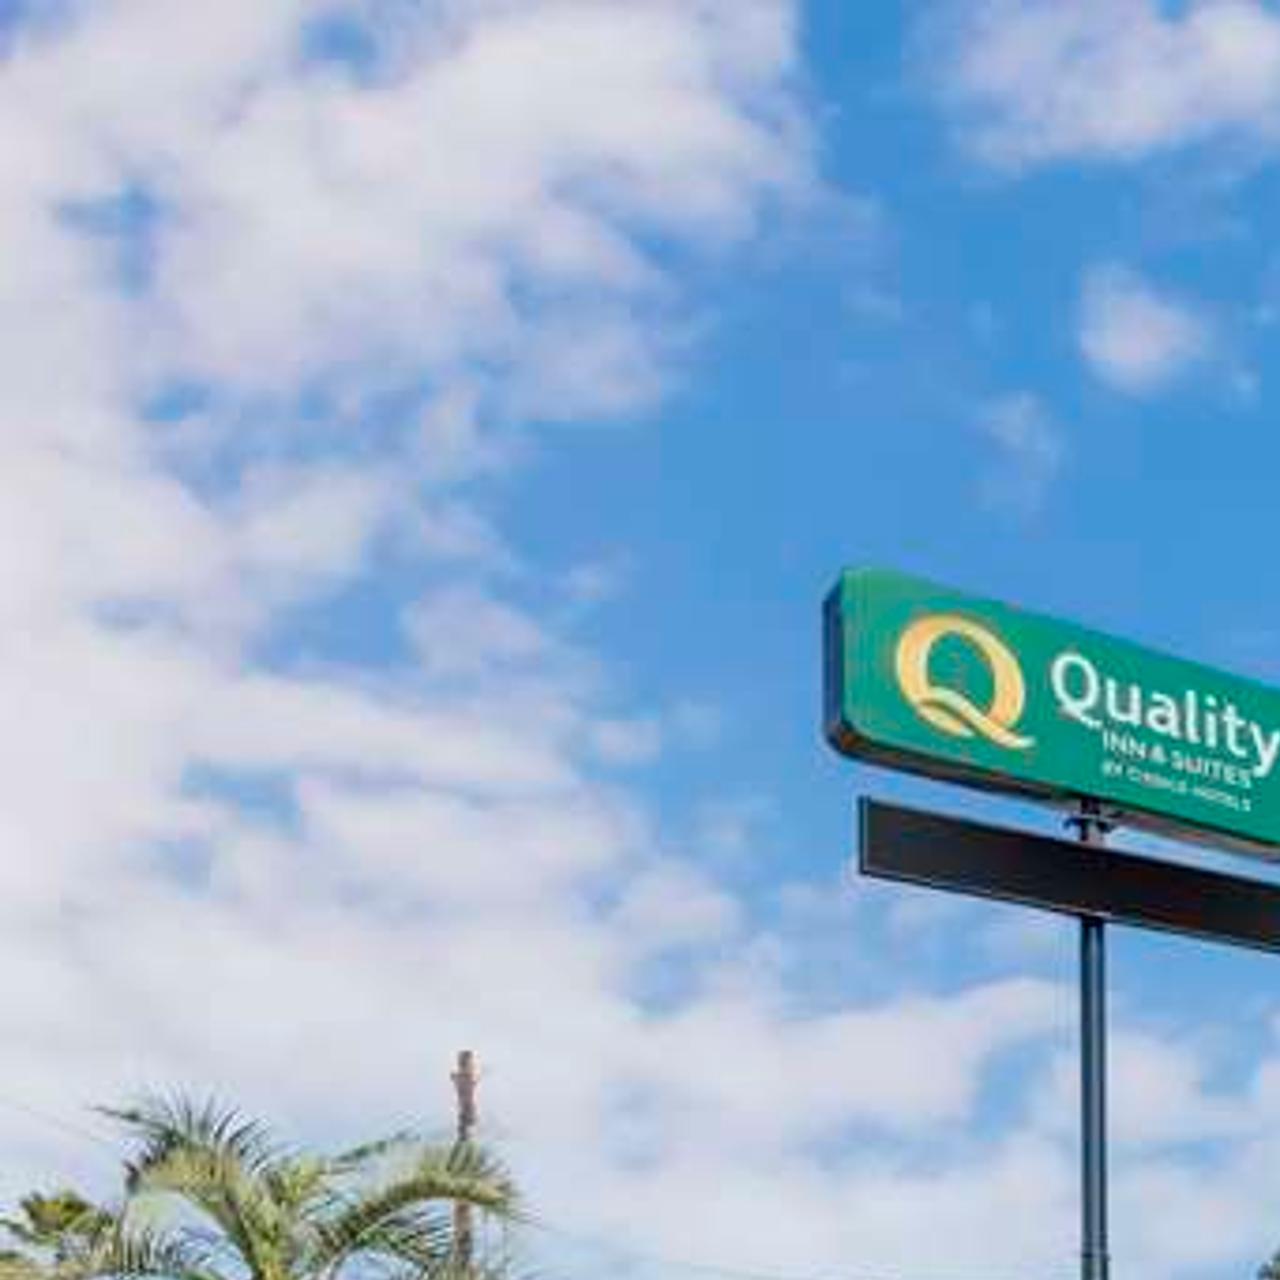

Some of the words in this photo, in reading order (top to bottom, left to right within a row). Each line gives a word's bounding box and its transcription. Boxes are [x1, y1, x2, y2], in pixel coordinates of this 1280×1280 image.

[897, 613, 1036, 748] Q
[1103, 730, 1147, 760] INN
[1171, 750, 1251, 788] SUITES
